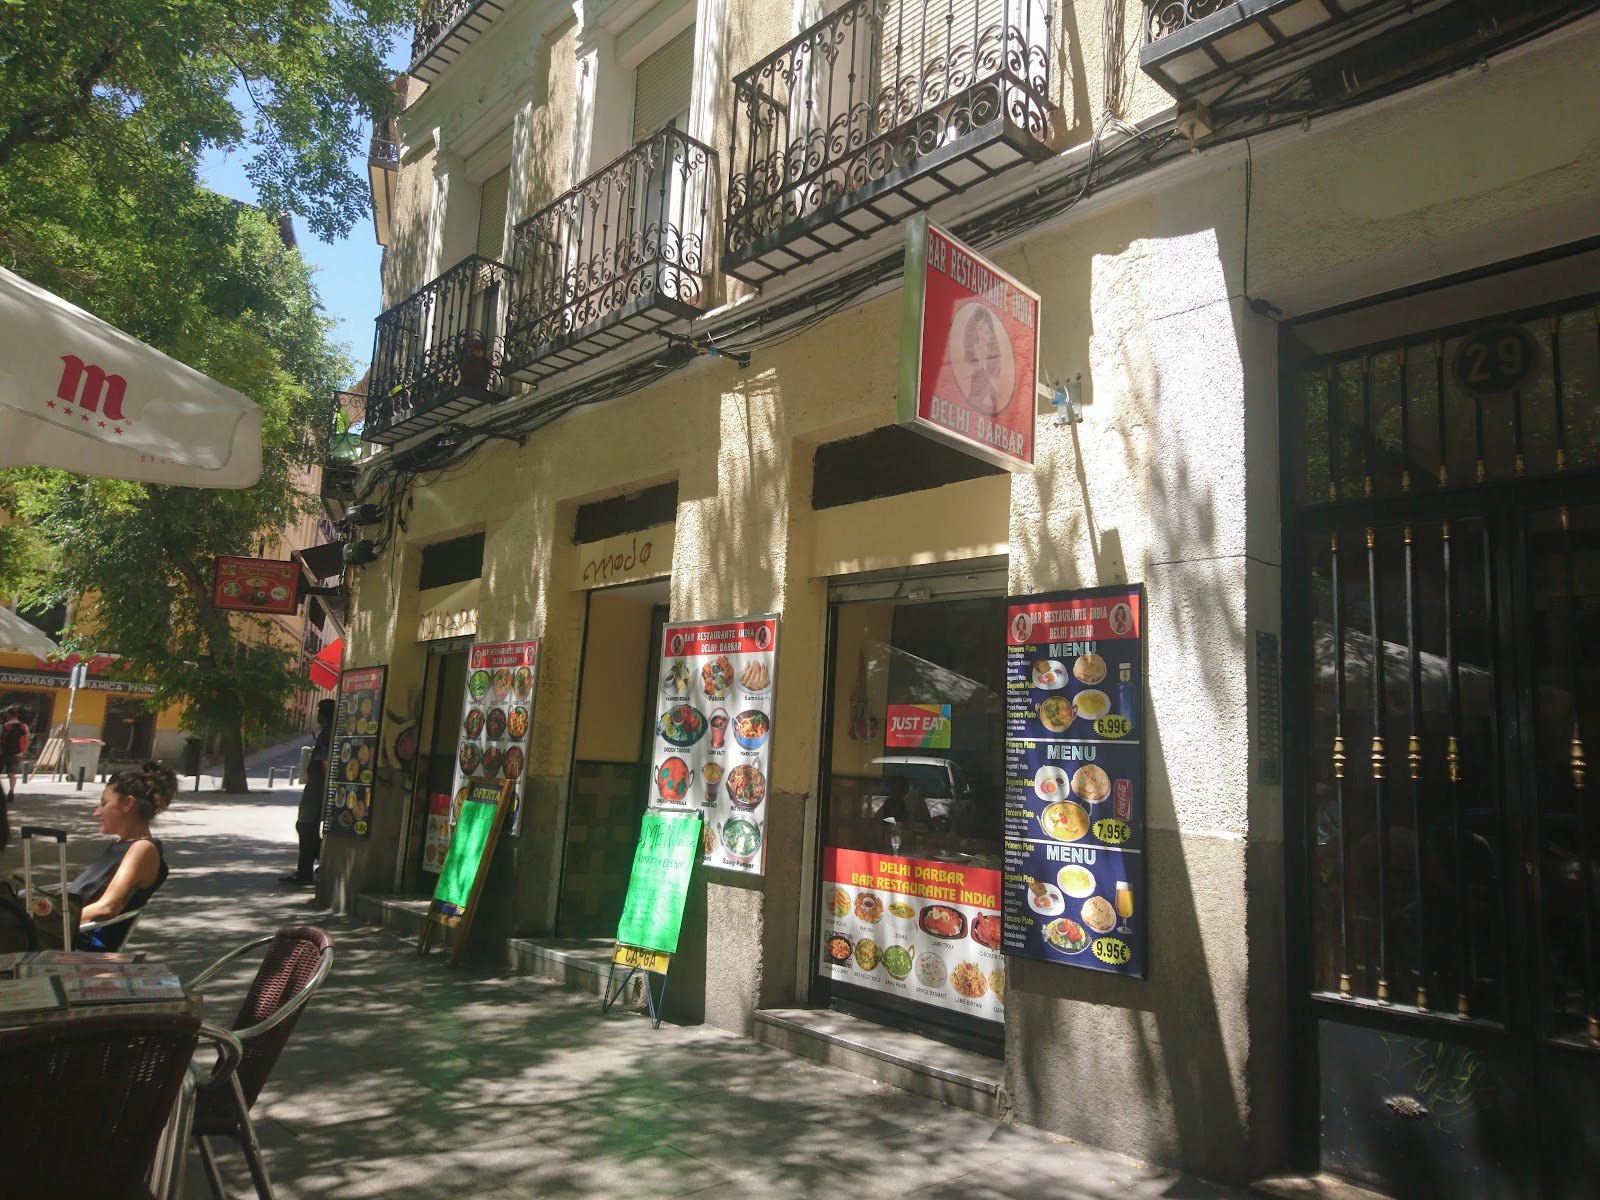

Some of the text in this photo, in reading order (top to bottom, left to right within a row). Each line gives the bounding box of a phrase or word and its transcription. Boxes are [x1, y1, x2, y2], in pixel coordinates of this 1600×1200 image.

[928, 232, 1033, 329] BAR RESTAURANTE INDIA
[1465, 336, 1522, 382] 29
[931, 395, 1023, 456] DELHI DARBAR
[1030, 607, 1107, 624] BAR RESTAURANTE INDIA
[697, 630, 736, 641] RESTAURANTE
[738, 629, 754, 638] INDIA
[1049, 625, 1094, 639] DELHI DARBAR
[701, 642, 742, 653] DELHI DARBAR
[1049, 641, 1096, 657] MENU
[0, 674, 54, 686] AMPARAS
[891, 717, 945, 732] JUST EAT
[1097, 718, 1127, 734] 6.99€
[1047, 745, 1096, 761] MENU
[1006, 778, 1023, 786] Segundo
[1005, 808, 1034, 818] Tercero Plato
[1097, 823, 1127, 840] 7.95€
[1005, 841, 1034, 851] Primero Plato
[1047, 845, 1096, 865] MENU
[880, 861, 965, 886] DELHI DARBAR
[1023, 874, 1034, 883] Plato
[852, 873, 996, 908] BAR RESTAURANTE INDIA
[1096, 941, 1127, 961] 9.95€
